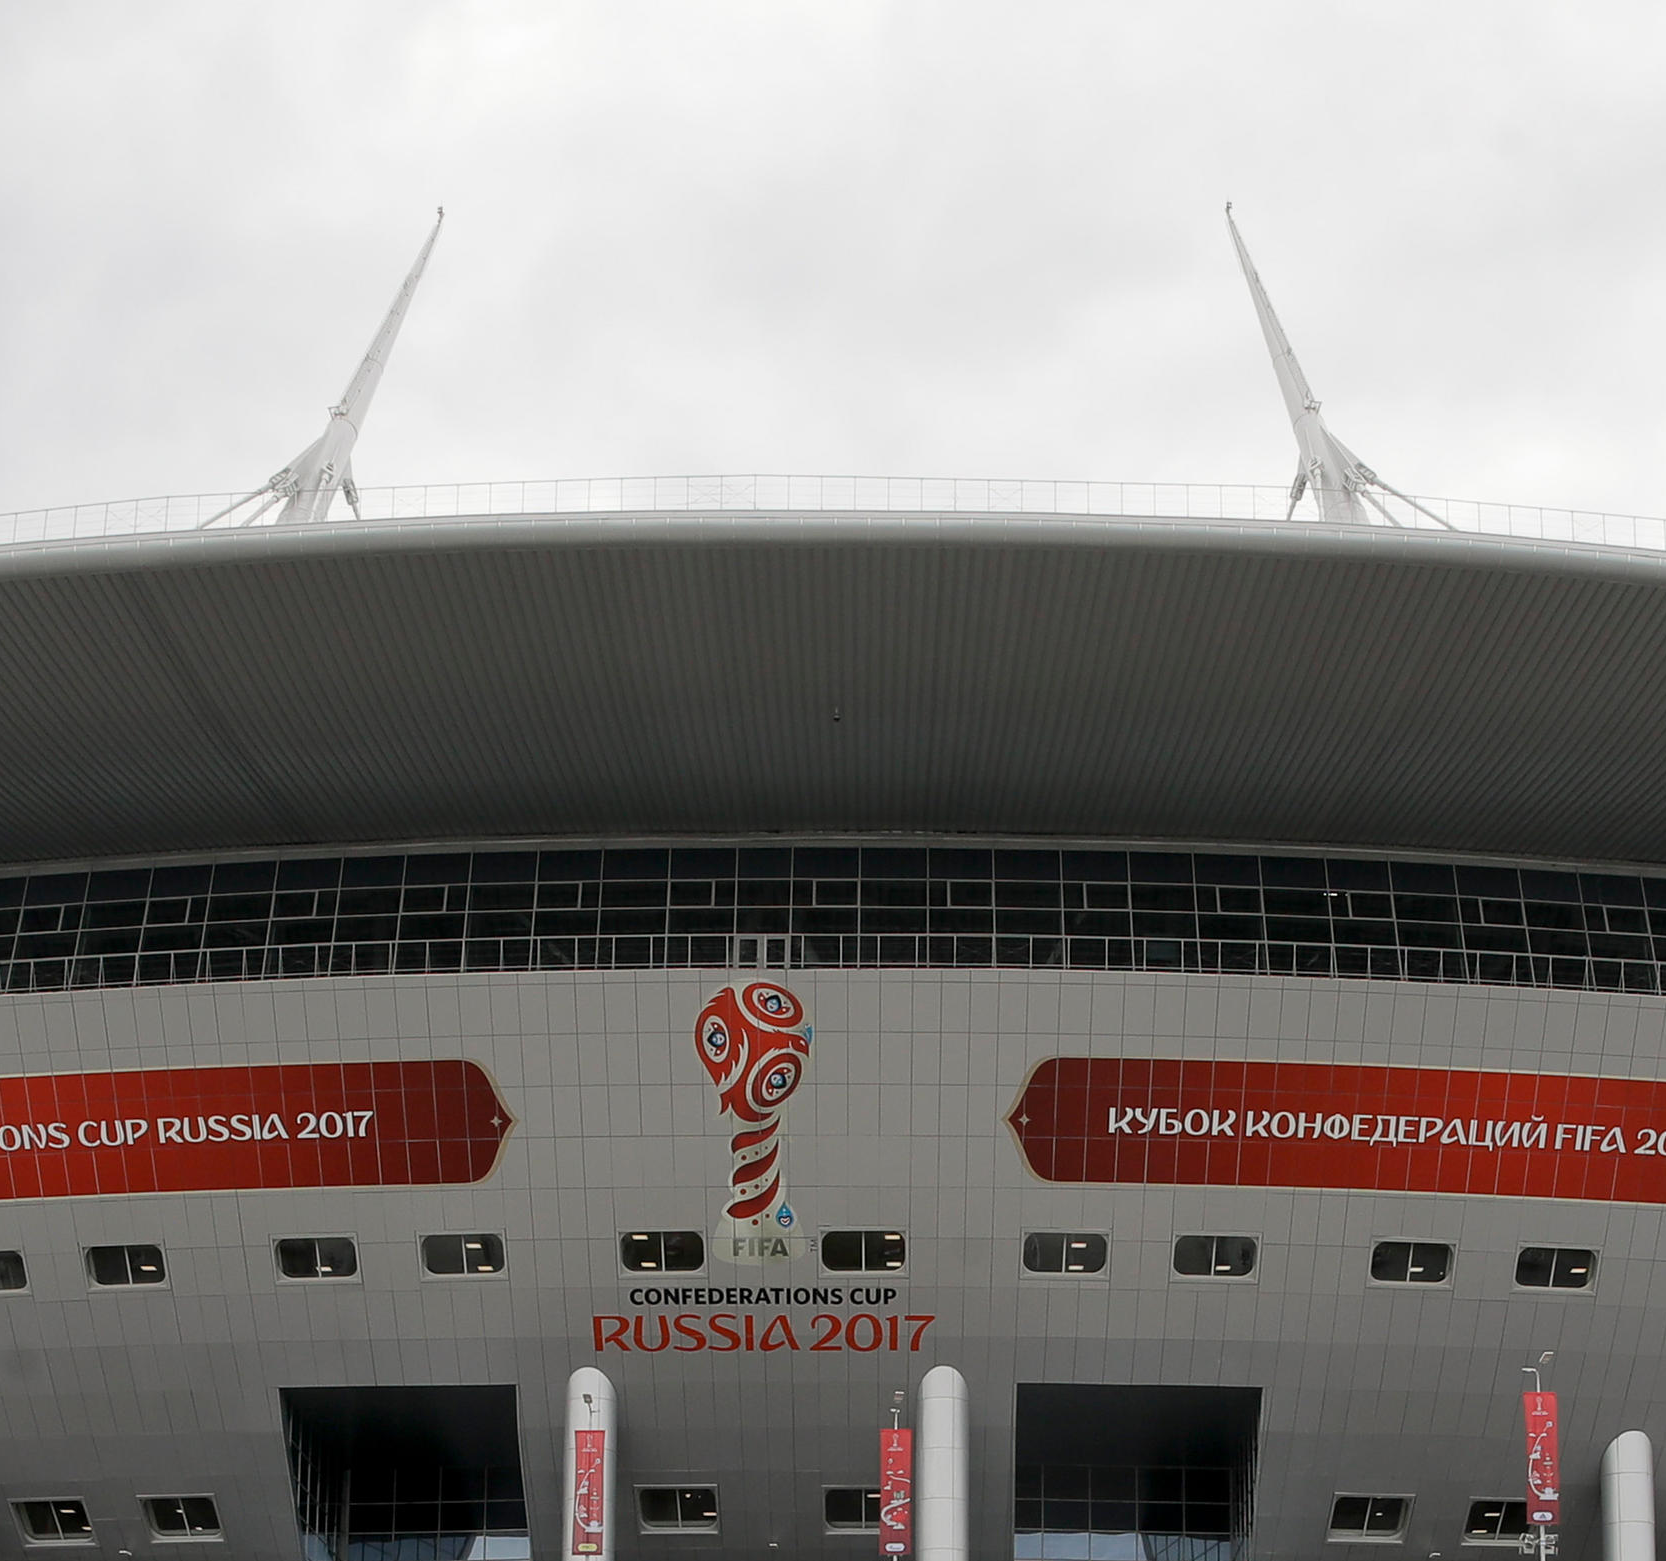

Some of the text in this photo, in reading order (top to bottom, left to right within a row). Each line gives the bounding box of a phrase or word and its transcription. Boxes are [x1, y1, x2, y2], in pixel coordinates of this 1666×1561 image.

[78, 1118, 148, 1147] CUP
[156, 1113, 289, 1144] RUSSIA
[296, 1111, 374, 1139] 2017
[1108, 1106, 1236, 1137] КУБОК
[1245, 1110, 1547, 1151] КОНФЕДЕРАЦИЙ
[1554, 1123, 1627, 1154] FIFA
[733, 1238, 789, 1257] FIFA
[629, 1287, 897, 1306] CONFEDERATIONS CUP
[593, 1313, 936, 1352] RUSSIA 2017
